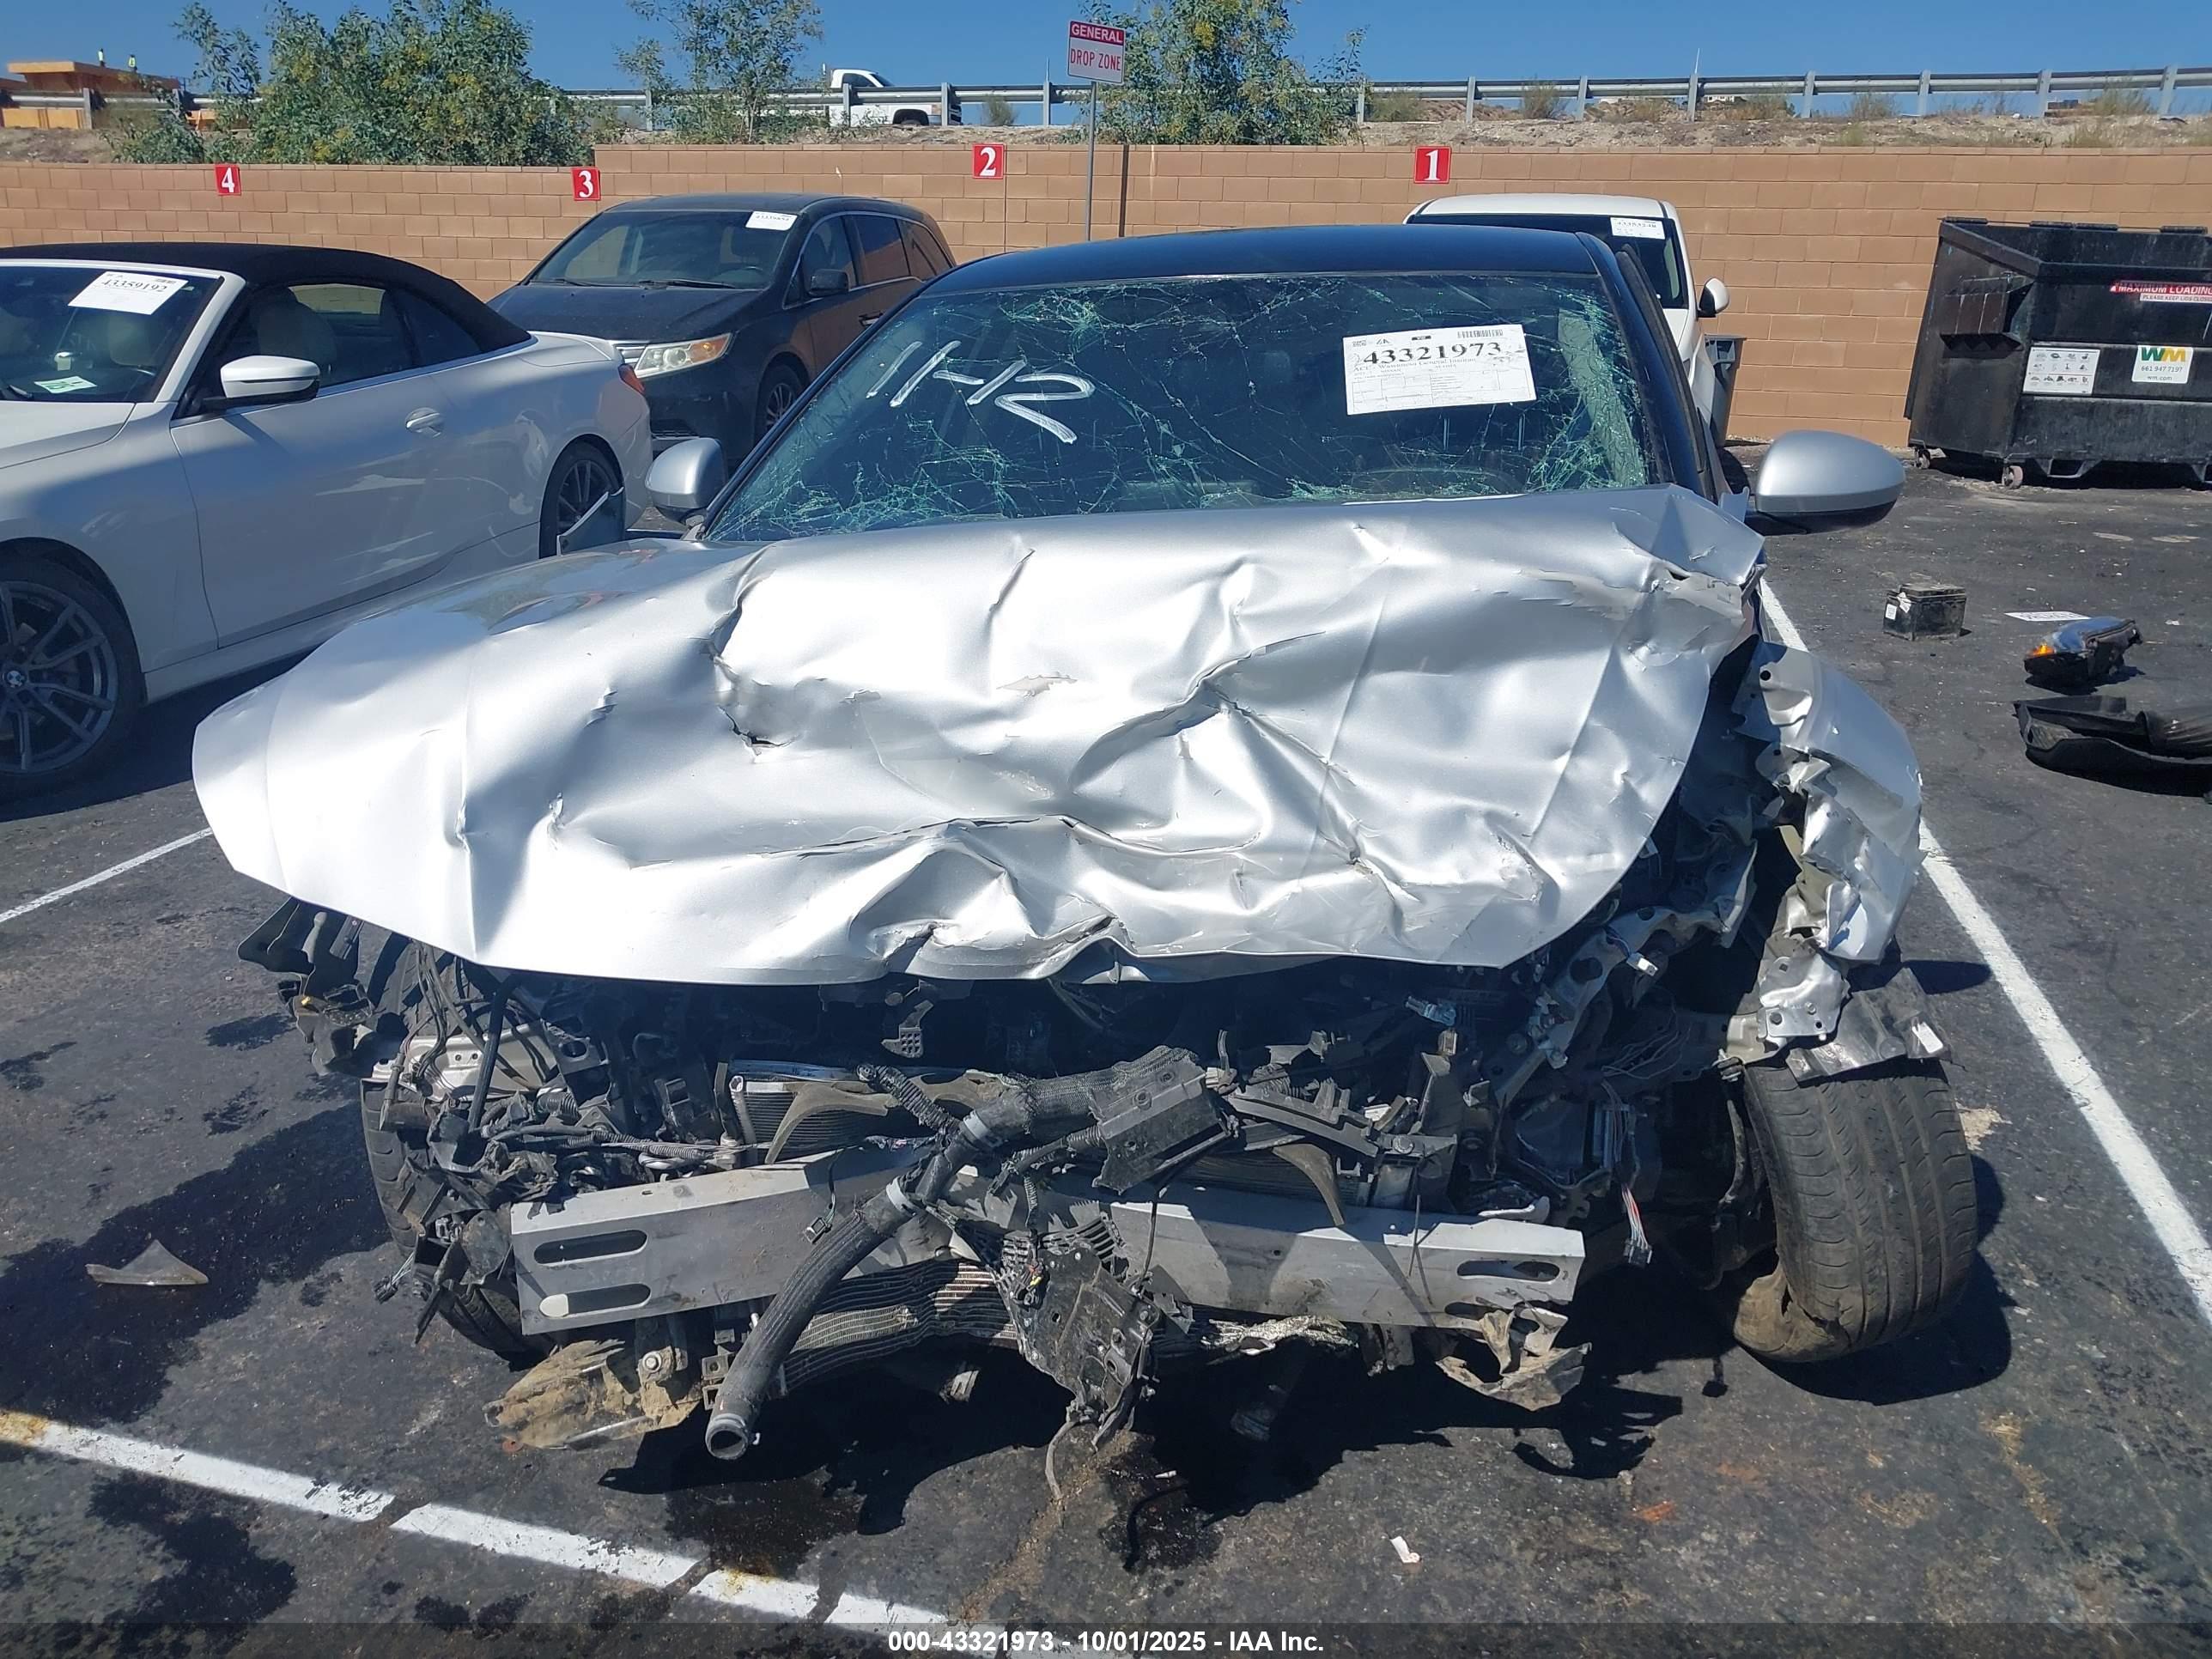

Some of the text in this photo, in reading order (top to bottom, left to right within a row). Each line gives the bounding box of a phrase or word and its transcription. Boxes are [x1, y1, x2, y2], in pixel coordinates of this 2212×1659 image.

[1071, 23, 1123, 43] GENERAL
[1070, 48, 1121, 71] DROP ZONE
[980, 147, 996, 177] 2
[1424, 149, 1441, 181] 1
[221, 167, 235, 193] 4
[578, 170, 594, 198] 3
[1363, 342, 1502, 364] 43321973
[2141, 347, 2186, 362] WM
